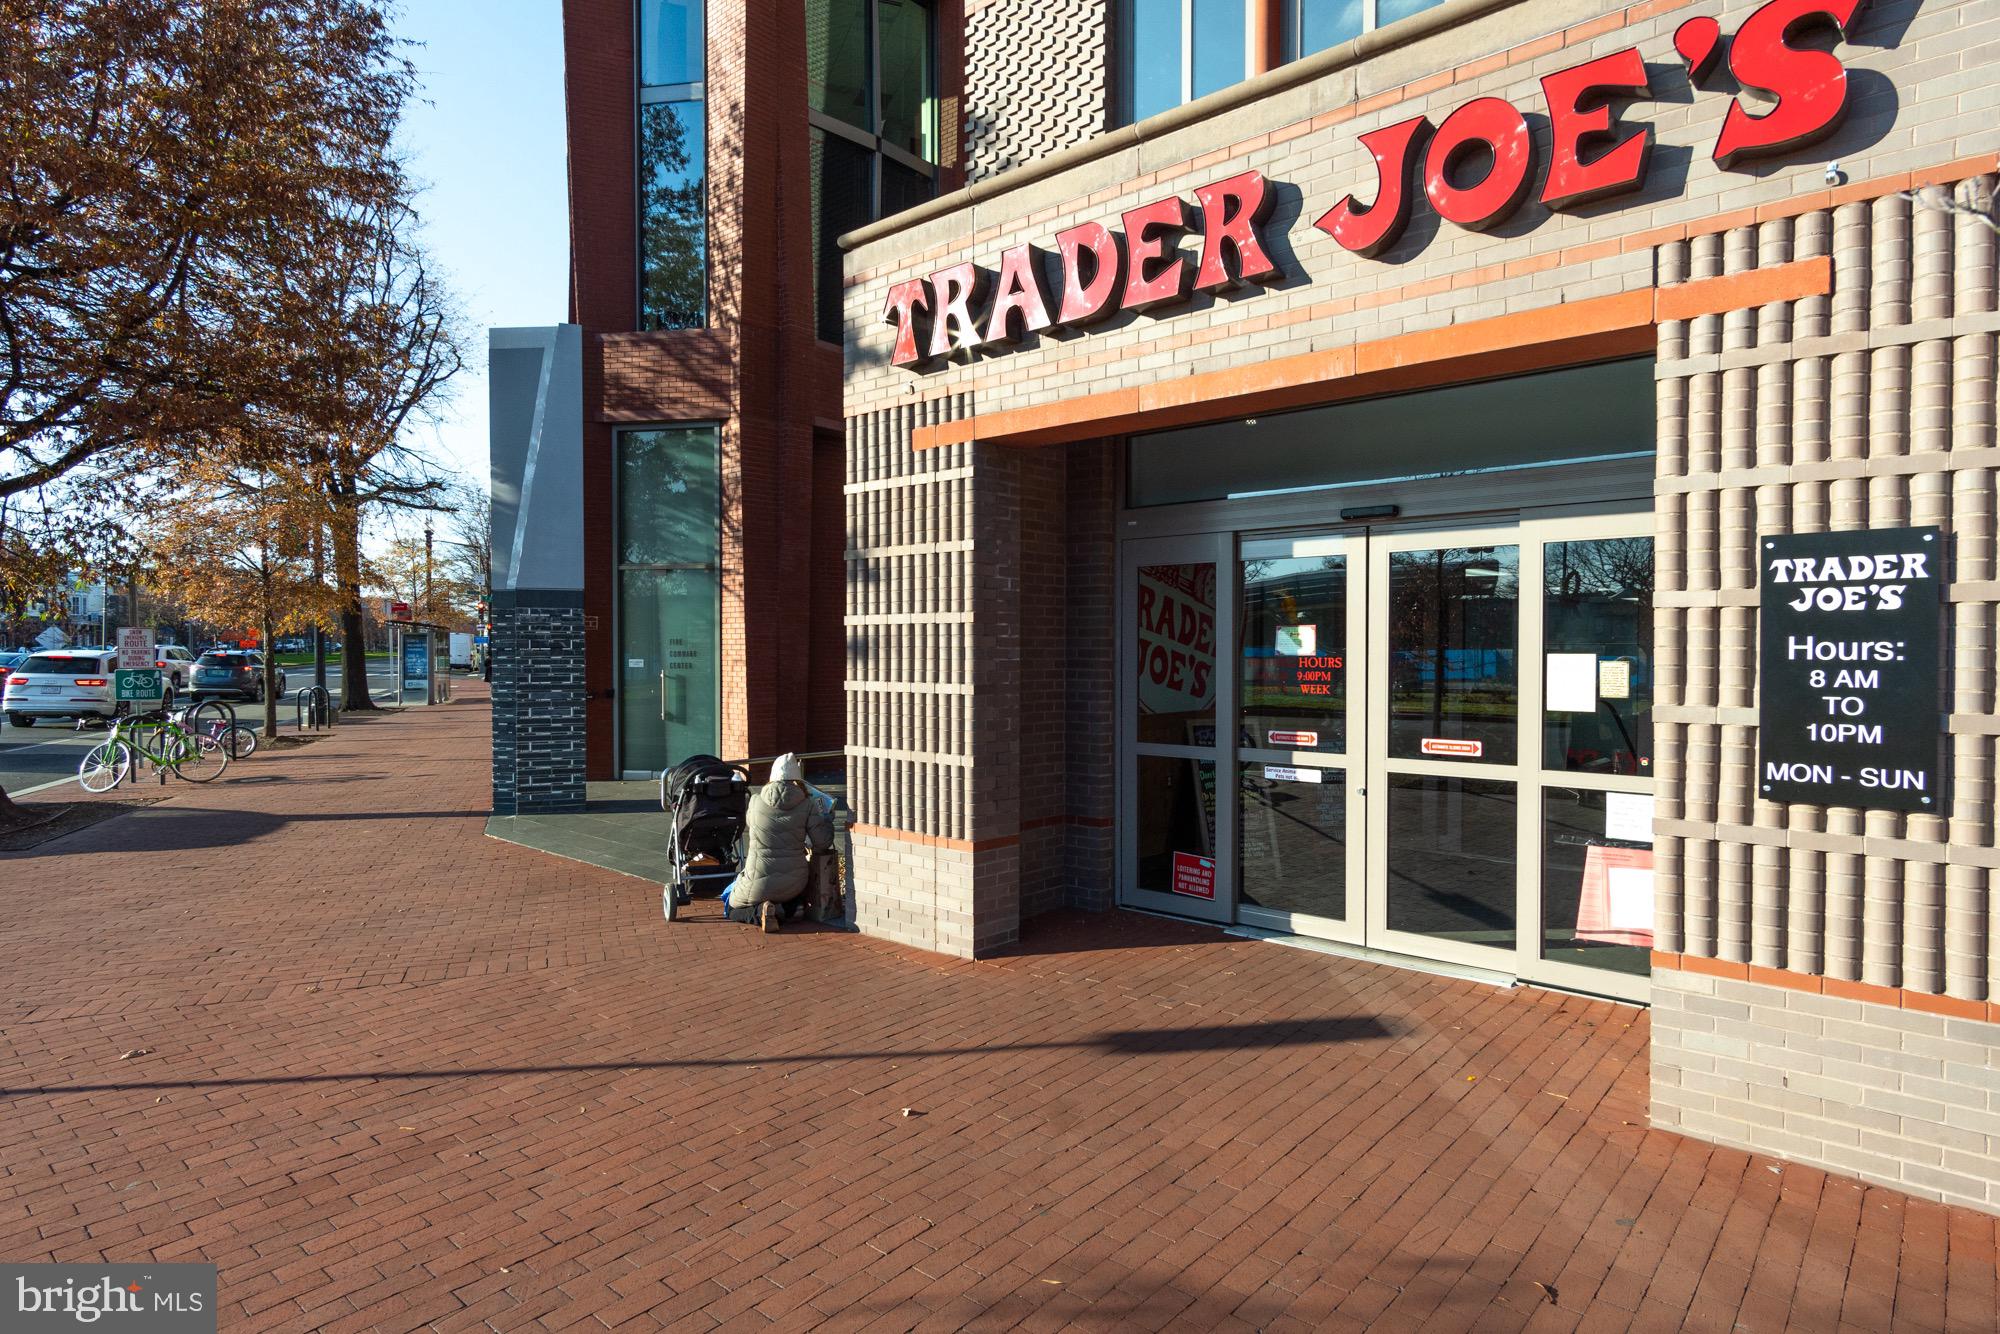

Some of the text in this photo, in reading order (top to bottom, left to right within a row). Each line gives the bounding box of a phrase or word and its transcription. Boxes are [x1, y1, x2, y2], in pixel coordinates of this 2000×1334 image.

[884, 0, 1865, 369] TRADER JOE'S
[1768, 553, 1929, 583] TRADER
[1788, 584, 1907, 612] JOE'S
[1138, 583, 1216, 658] RADE
[1788, 635, 1905, 661] Hours:
[1298, 657, 1343, 669] HOURS
[1297, 671, 1331, 682] 9:00PM
[1809, 669, 1879, 689] 8 AM
[121, 689, 156, 698] BIKE ROUTE
[1300, 684, 1331, 695] WEEK
[1822, 696, 1864, 716] TO
[1806, 723, 1882, 744] 10PM
[1766, 762, 1834, 785] MON
[1859, 767, 1926, 791] SUN
[1201, 869, 1212, 878] AND
[1178, 881, 1209, 894] NOT ALLOWED
